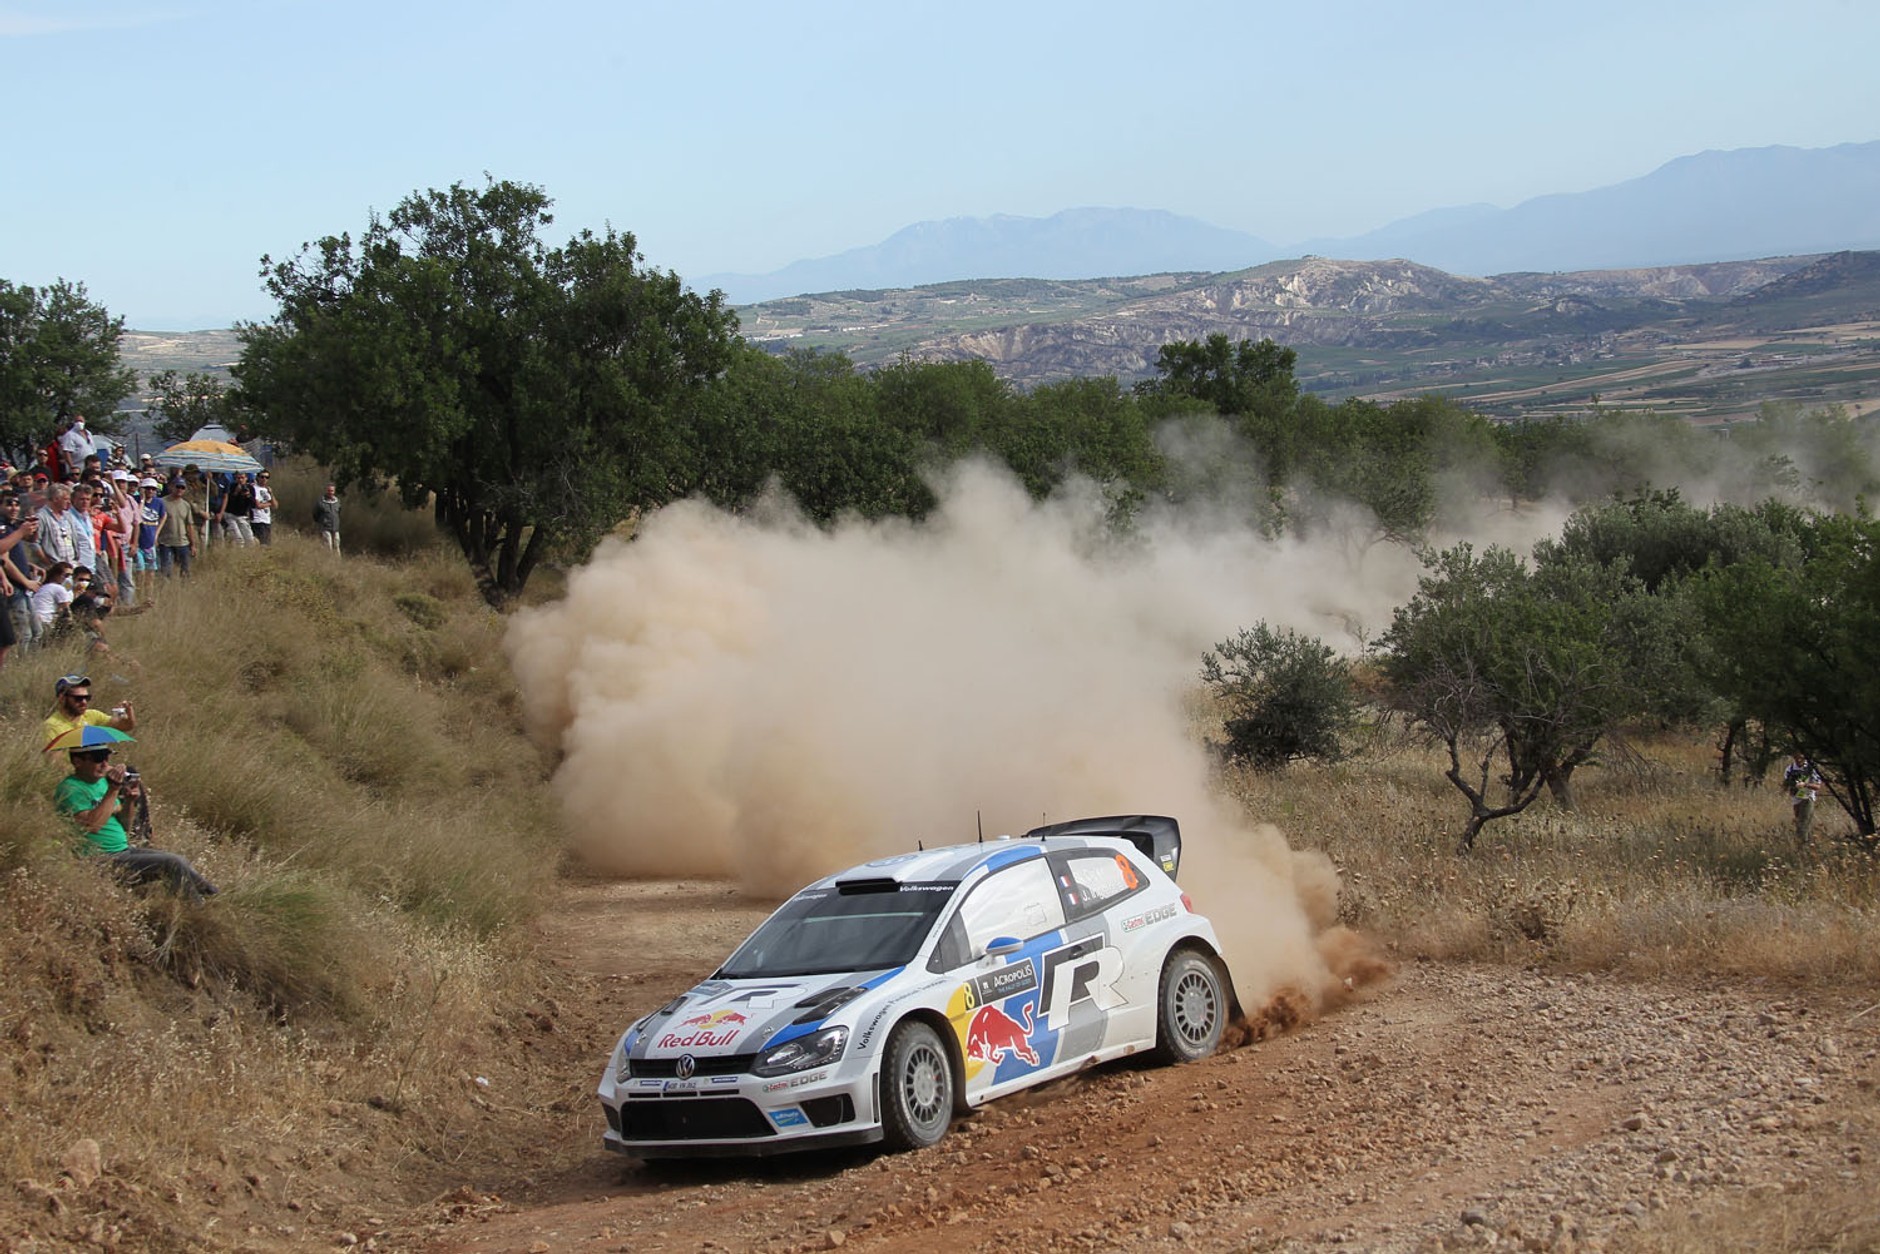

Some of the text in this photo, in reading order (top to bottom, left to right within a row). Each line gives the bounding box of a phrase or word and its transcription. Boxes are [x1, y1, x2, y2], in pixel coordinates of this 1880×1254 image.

[1115, 853, 1137, 890] 8
[900, 885, 954, 893] Volkswagen
[1145, 903, 1177, 925] EDGE
[994, 965, 1033, 987] ACROPOLIS
[1038, 932, 1128, 1031] R
[963, 981, 975, 1009] 8
[857, 1003, 893, 1050] Volkswagen
[657, 1029, 740, 1048] Red Bull
[790, 1070, 827, 1088] EDGE
